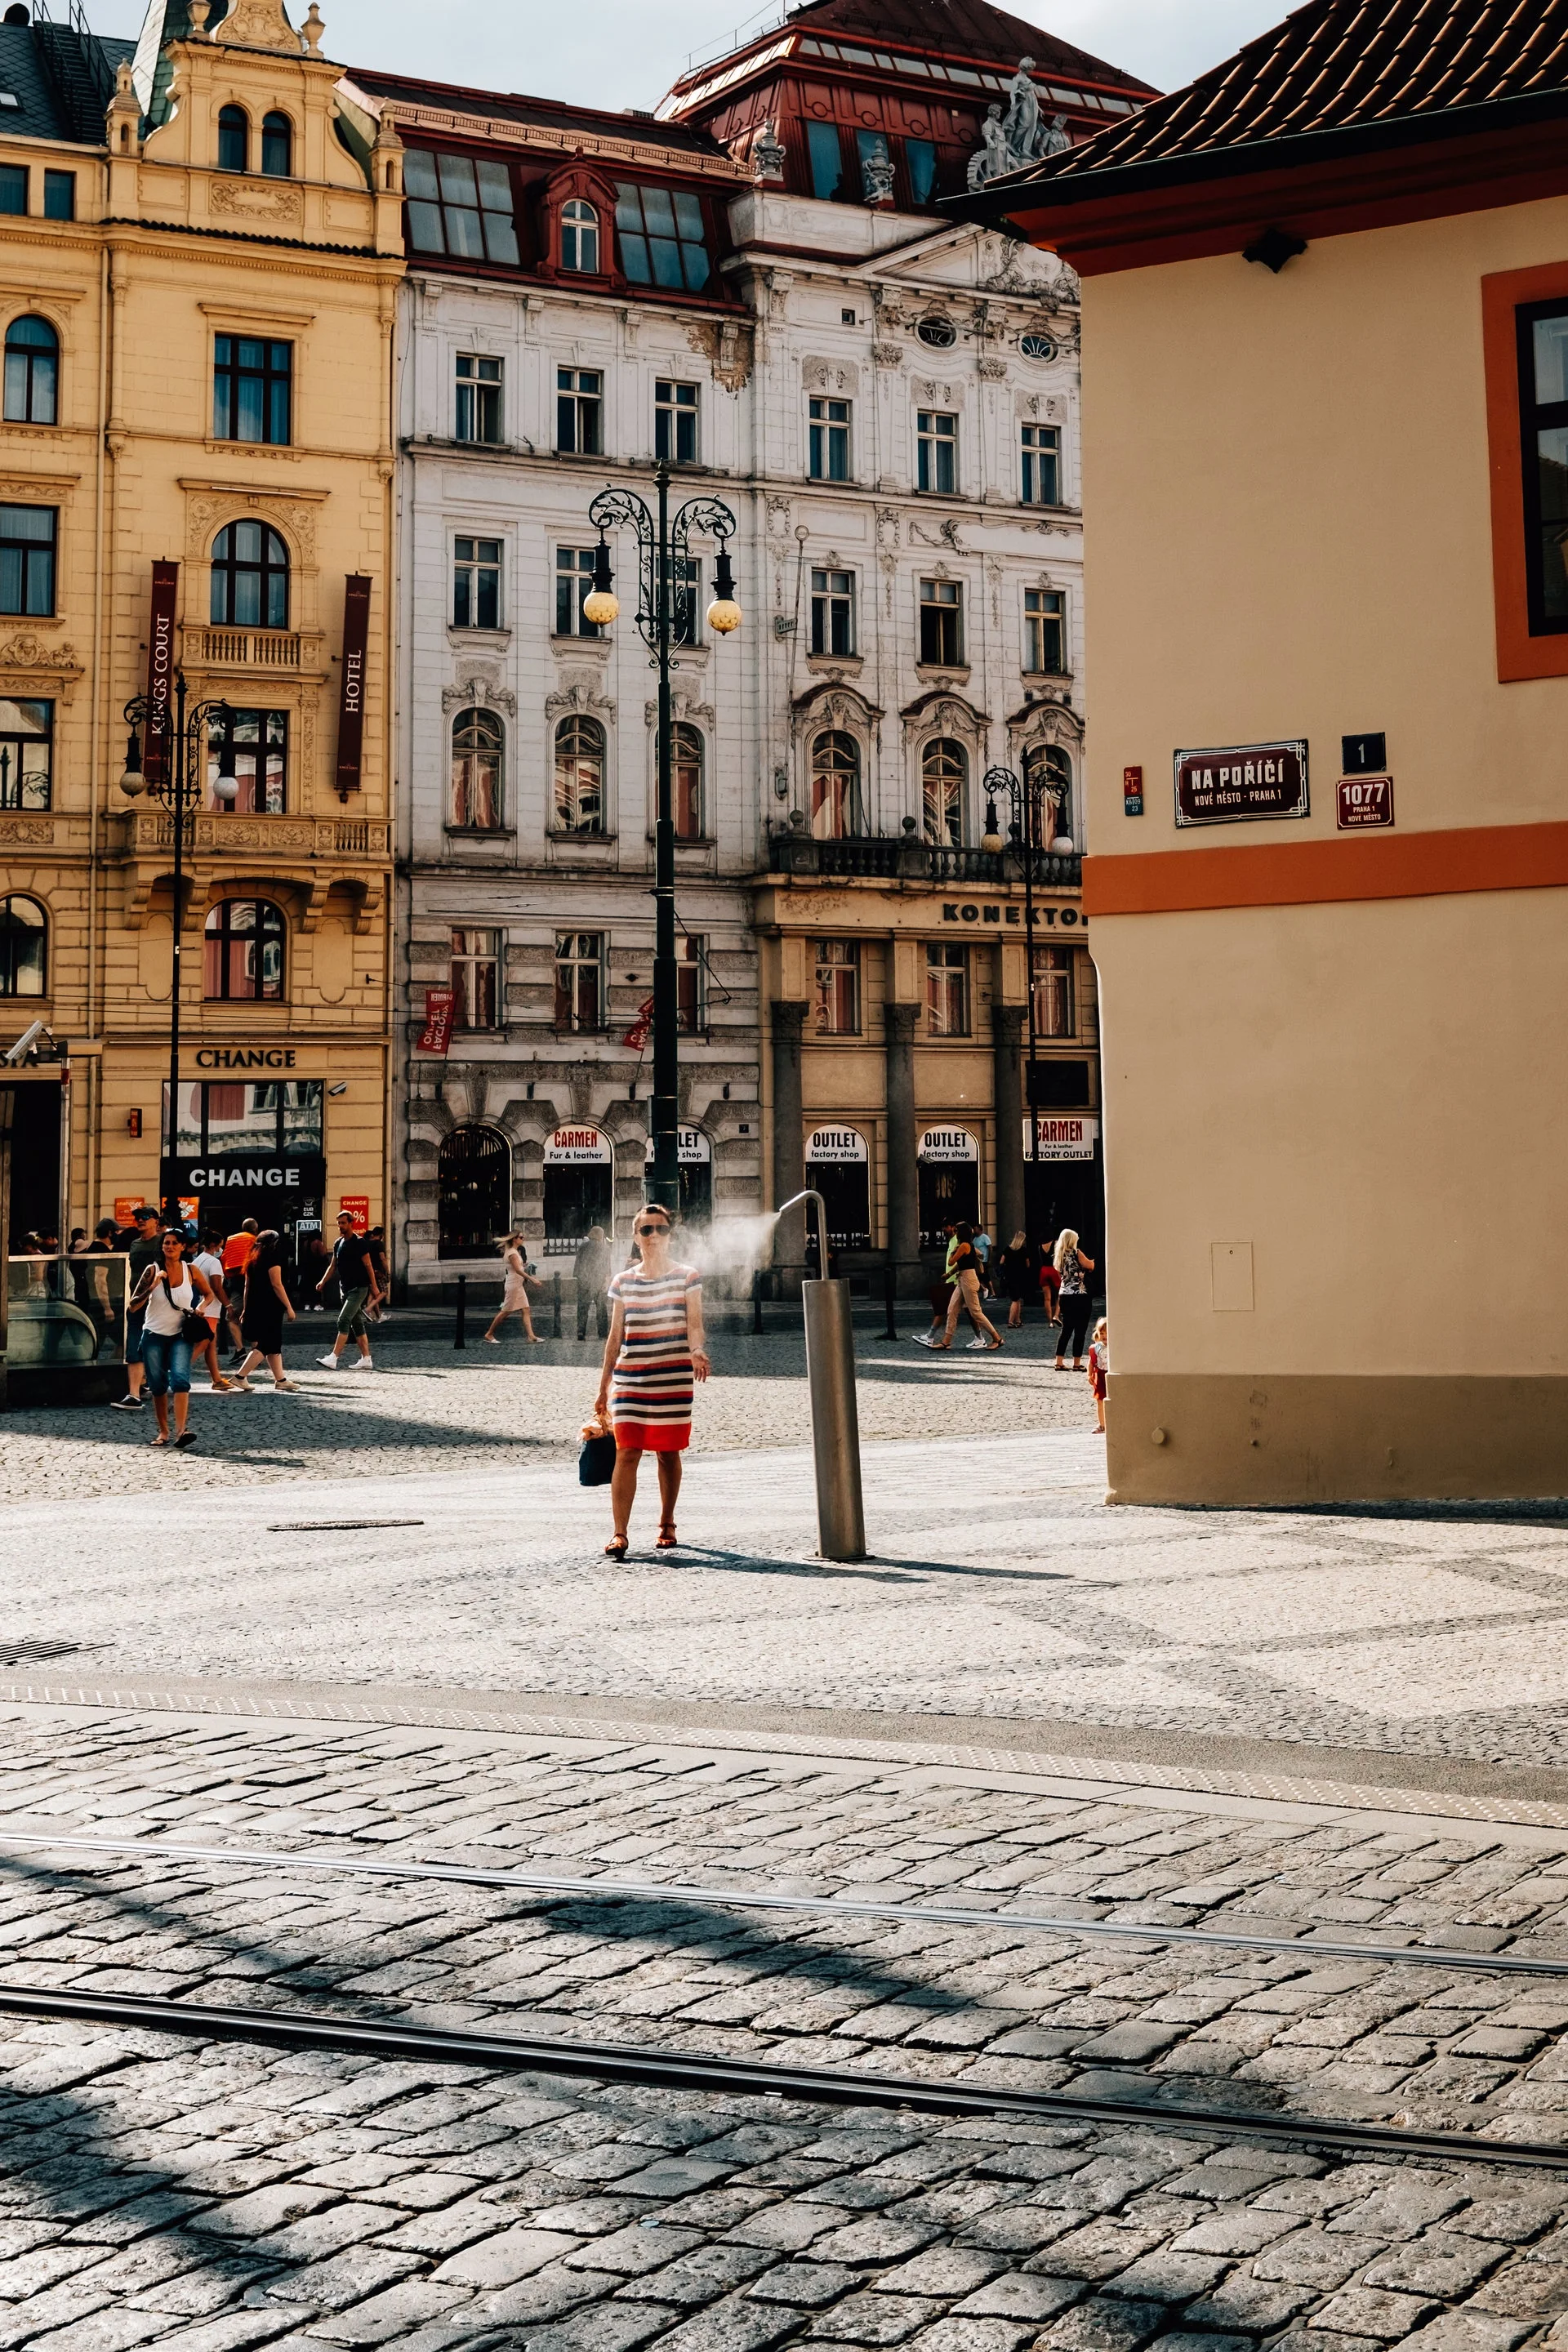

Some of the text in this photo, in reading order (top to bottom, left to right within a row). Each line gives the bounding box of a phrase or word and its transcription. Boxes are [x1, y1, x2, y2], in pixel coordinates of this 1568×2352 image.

[154, 613, 170, 673] COURT
[345, 649, 362, 713] HOTEL
[1358, 743, 1365, 764] 1
[1192, 758, 1284, 790] NA POŘÍČÍ
[1195, 791, 1214, 806] NOVÉ
[1217, 791, 1241, 804] MĚSTO
[1250, 789, 1276, 802] PRAHA
[1277, 789, 1281, 800] 1
[1342, 783, 1385, 805] 1077
[1348, 814, 1361, 822] NOVÉ
[943, 903, 1088, 926] KONEKTO
[196, 1049, 296, 1068] CHANGE
[554, 1130, 598, 1148] CARMEN
[678, 1132, 700, 1147] LET
[813, 1132, 857, 1147] OUTLET
[924, 1132, 967, 1147] OUTLET
[1036, 1120, 1083, 1142] CARMEN
[550, 1151, 603, 1160] Fur & leather
[682, 1150, 702, 1160] shop
[811, 1150, 860, 1160] factory shop
[951, 1150, 970, 1160] shop
[189, 1168, 300, 1187] CHANGE
[299, 1222, 318, 1231] ATM
